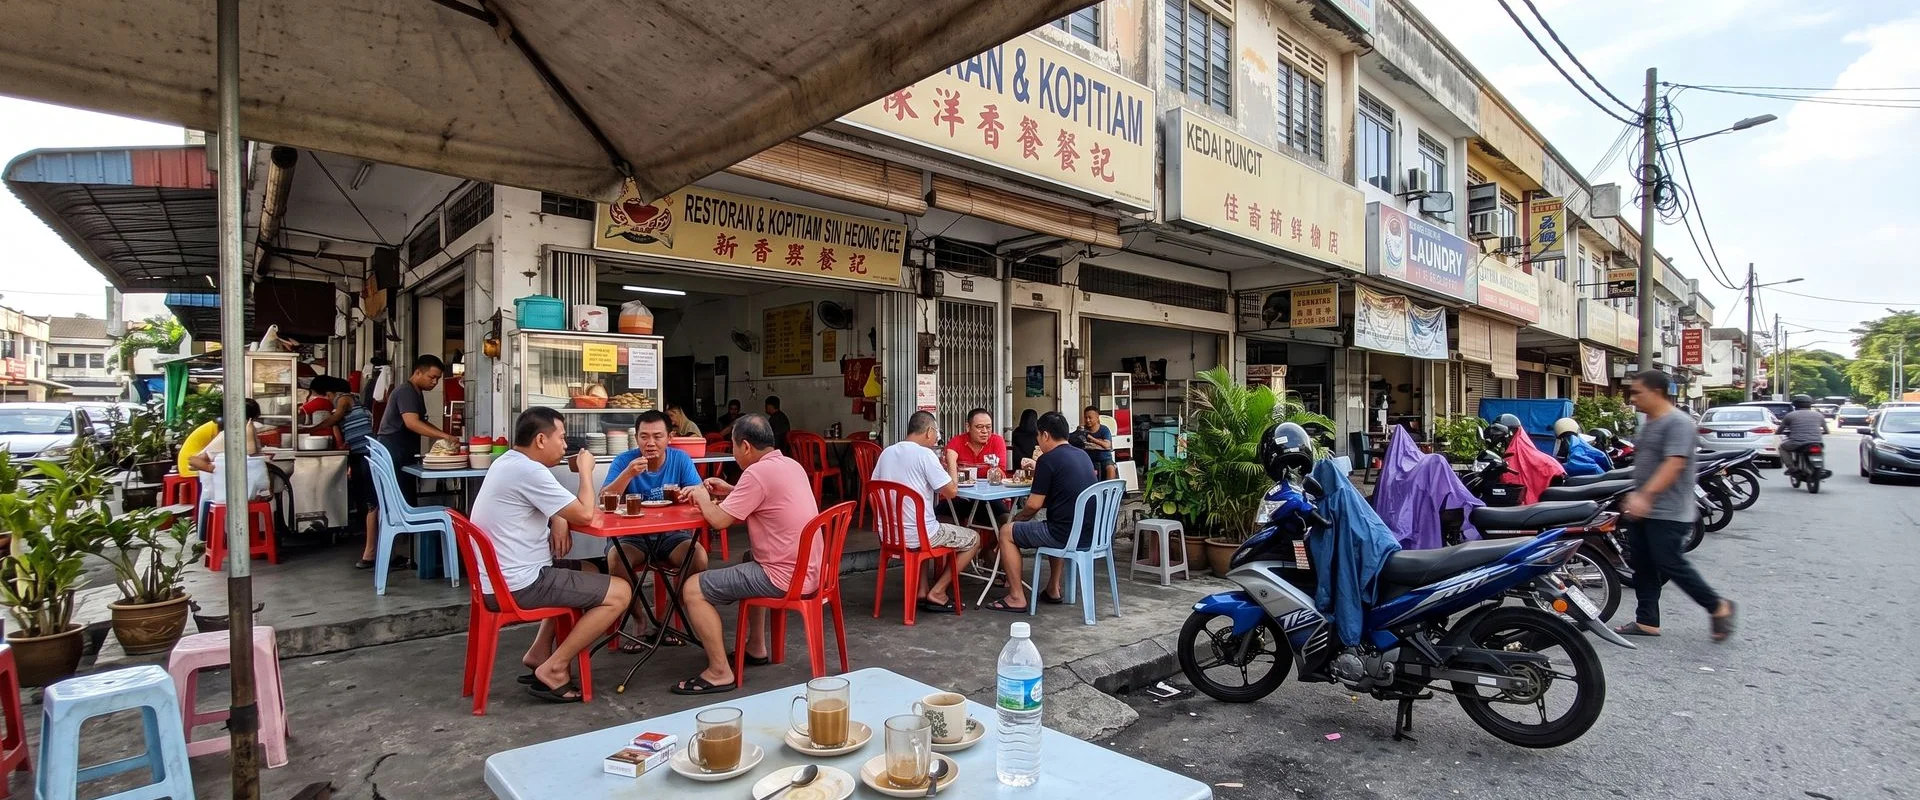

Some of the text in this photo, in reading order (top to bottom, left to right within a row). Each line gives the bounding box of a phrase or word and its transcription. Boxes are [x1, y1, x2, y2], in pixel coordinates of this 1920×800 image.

[1013, 48, 1030, 104] &
[1040, 58, 1143, 146] KOPITIAM
[1187, 121, 1262, 177] KEDAI RUNCIT
[685, 194, 901, 253] RESTORAN & KOPITIAM SIN HEONG KEE
[1410, 234, 1463, 277] LAUNDRY
